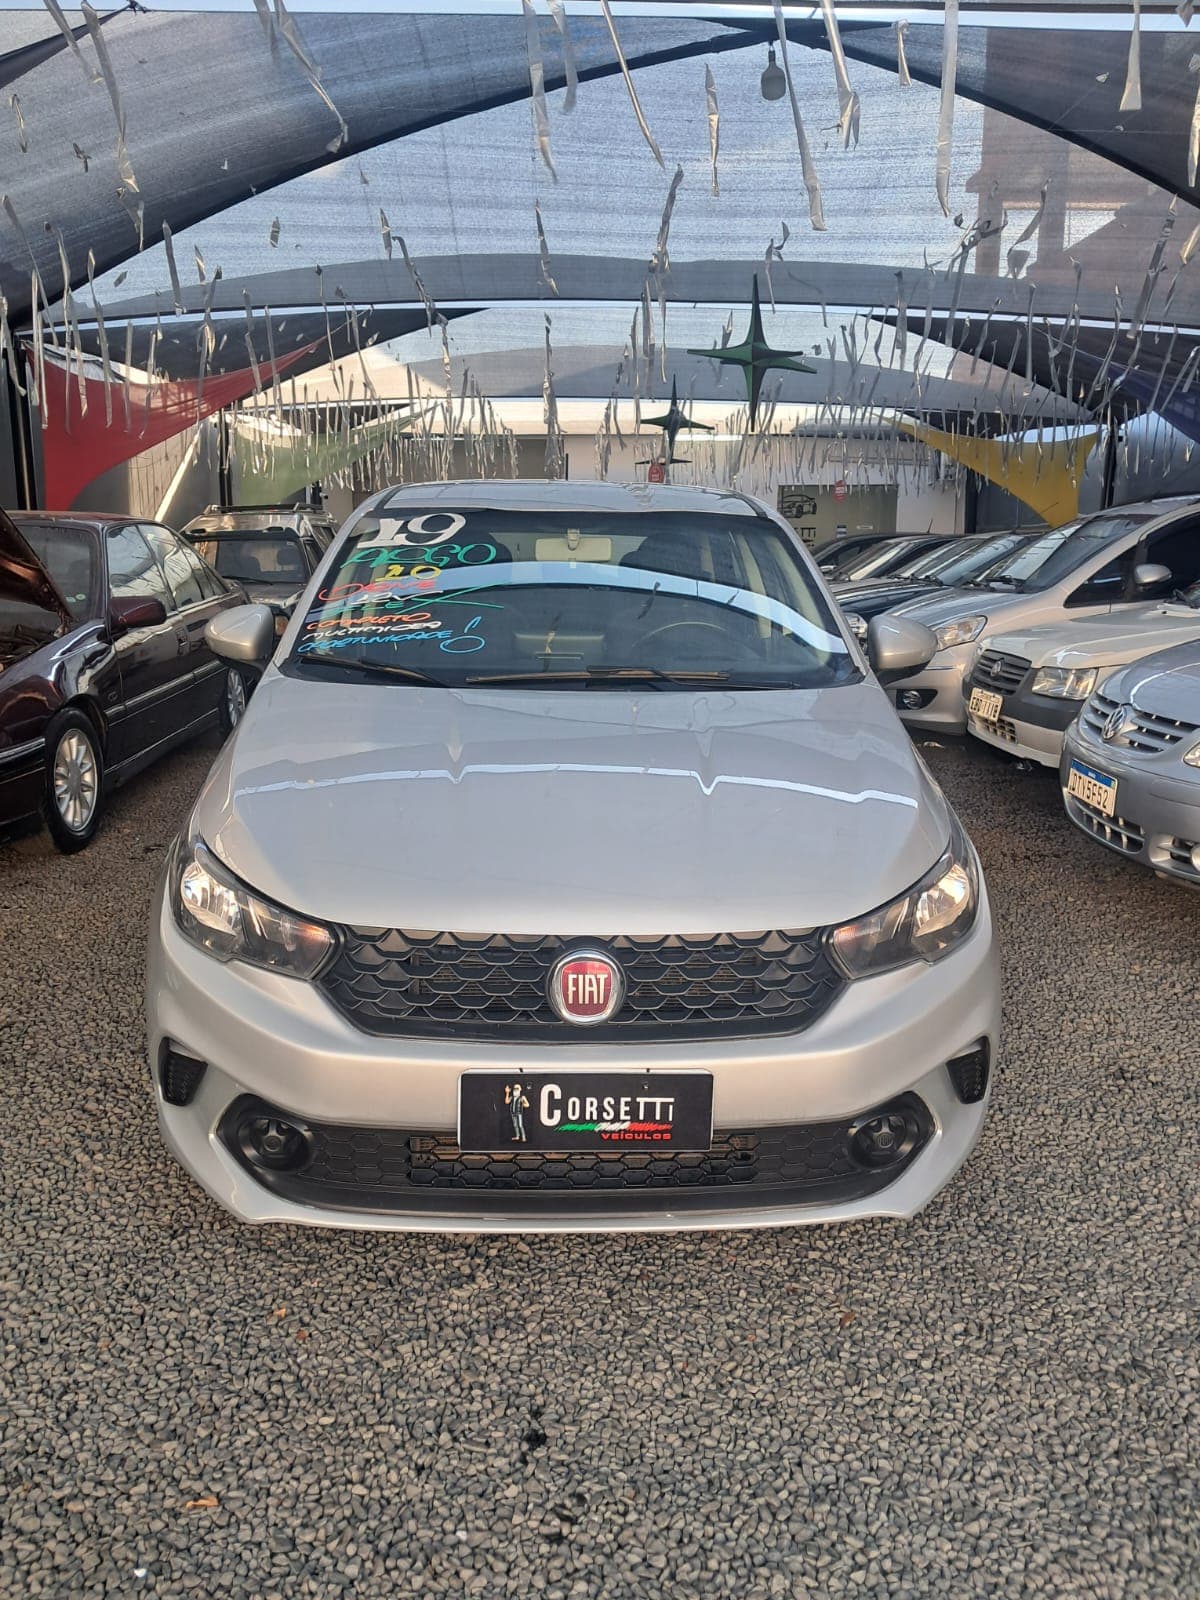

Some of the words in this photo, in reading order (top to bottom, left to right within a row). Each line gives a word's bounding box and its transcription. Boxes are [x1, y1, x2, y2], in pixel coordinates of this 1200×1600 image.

[356, 512, 467, 549] 19
[339, 543, 497, 569] ARGO
[567, 973, 608, 1005] FIAT
